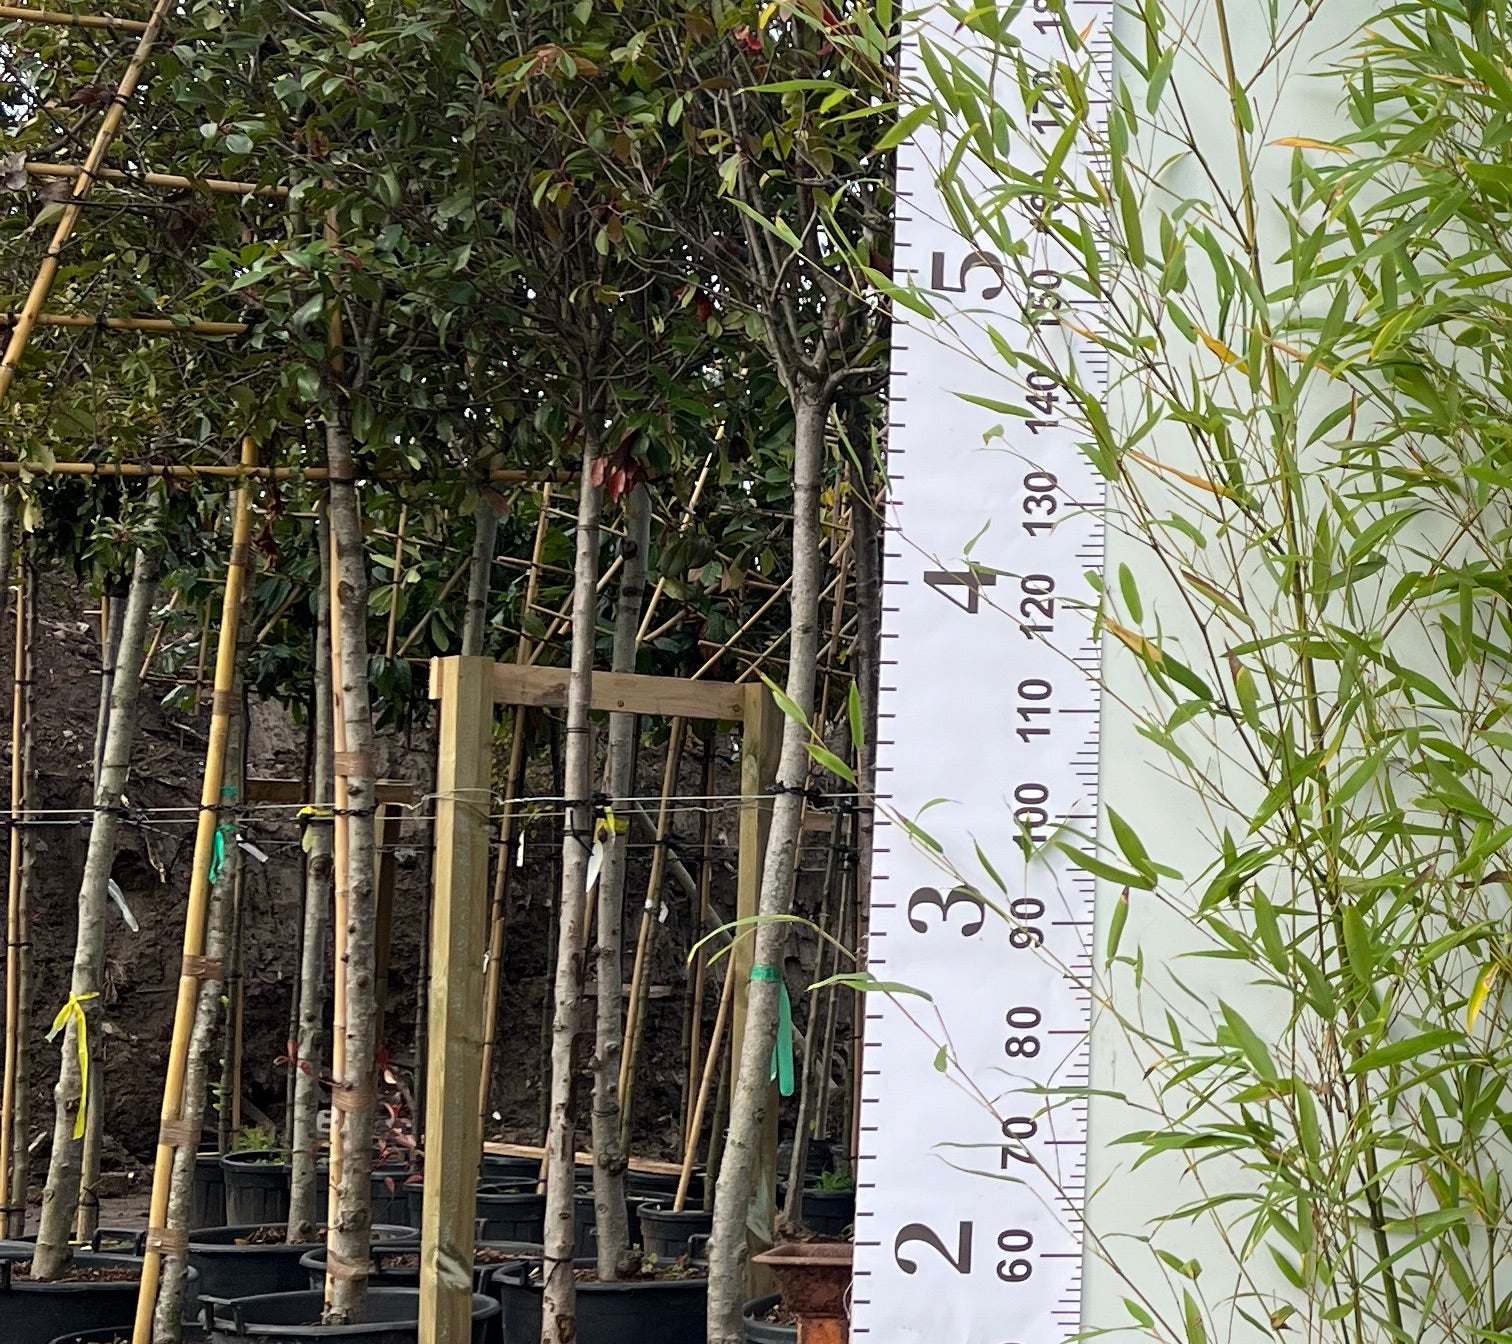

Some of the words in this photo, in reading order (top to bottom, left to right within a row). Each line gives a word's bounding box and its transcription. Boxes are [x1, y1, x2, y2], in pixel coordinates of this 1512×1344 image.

[931, 251, 1005, 300] 5
[1025, 370, 1061, 435] 140
[1022, 471, 1058, 537] 130
[923, 560, 997, 614] 4
[1019, 574, 1056, 641] 120
[1015, 678, 1052, 744] 110
[1012, 782, 1049, 850] 100
[907, 886, 986, 938] 3
[1008, 897, 1046, 950] 90
[1004, 1006, 1043, 1060] 80
[1000, 1116, 1038, 1170] 70
[894, 1220, 974, 1275] 2
[996, 1229, 1034, 1283] 60
